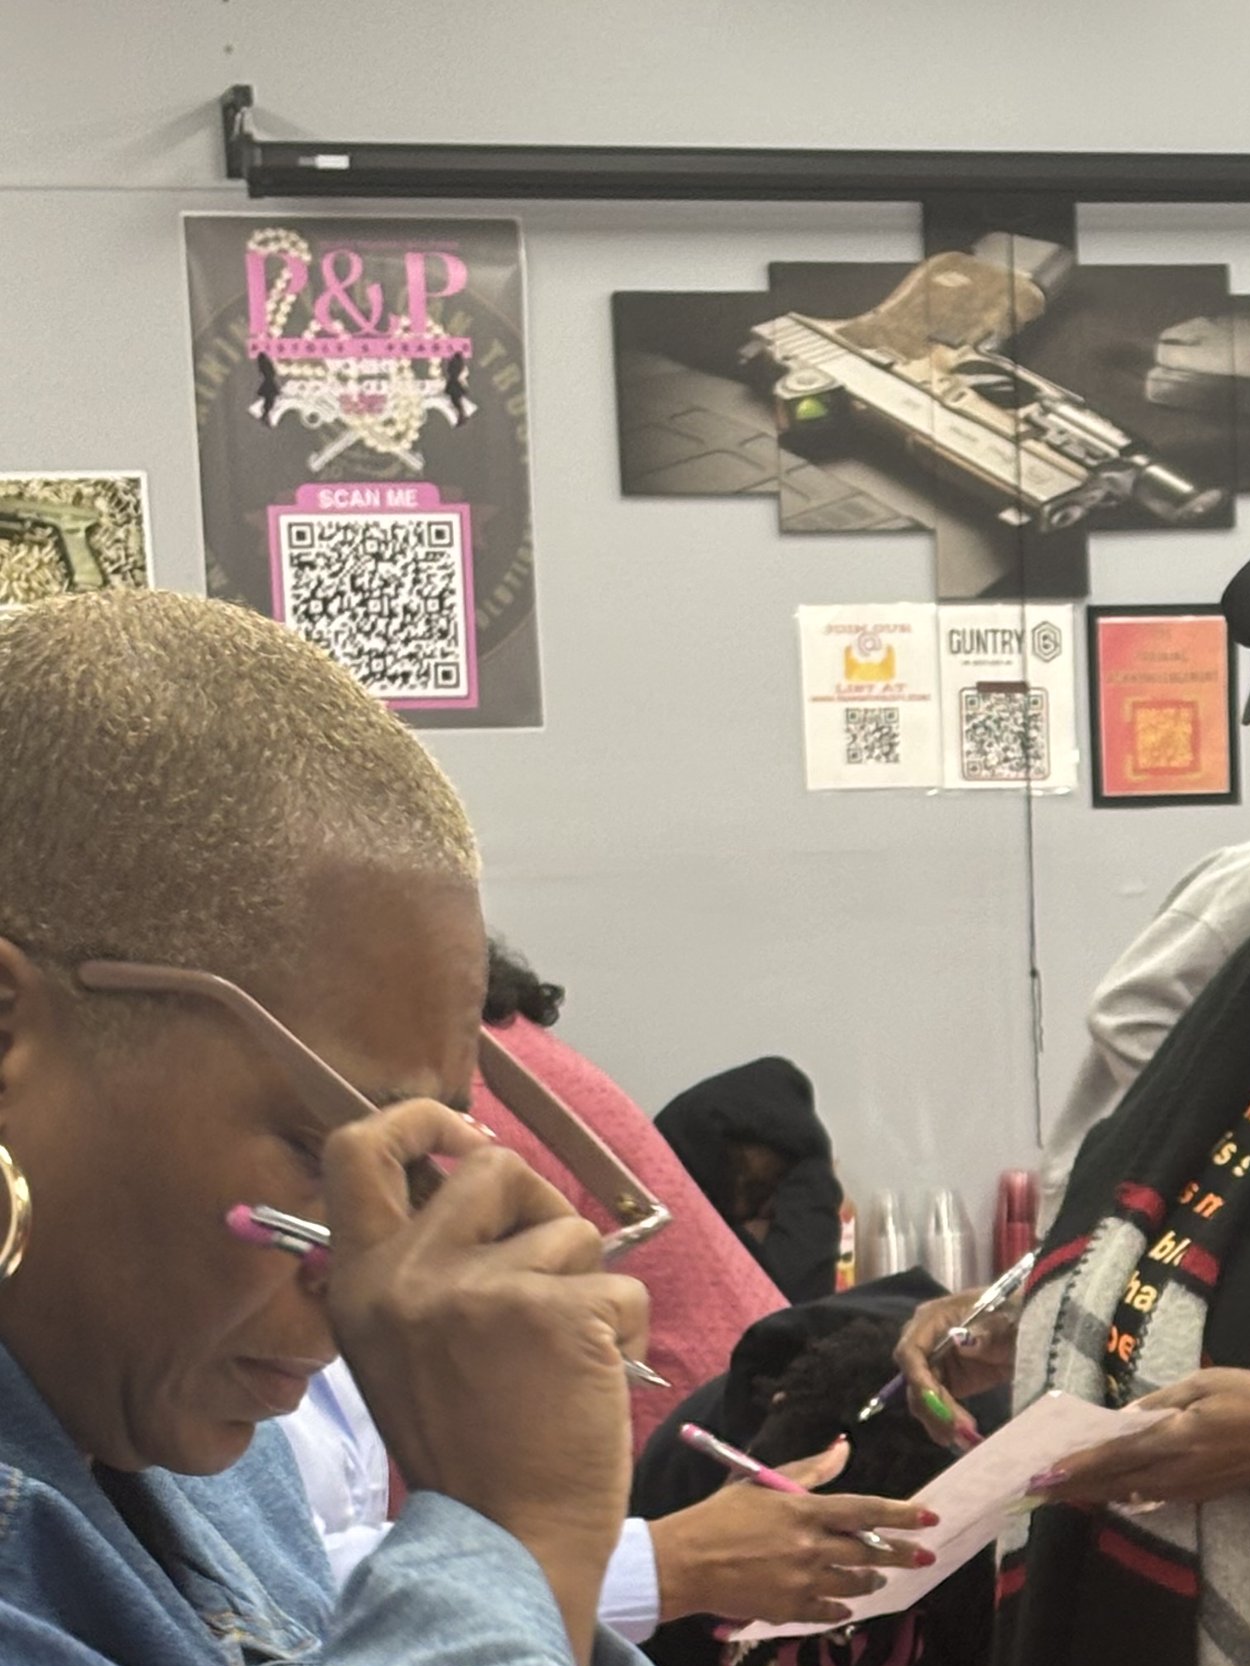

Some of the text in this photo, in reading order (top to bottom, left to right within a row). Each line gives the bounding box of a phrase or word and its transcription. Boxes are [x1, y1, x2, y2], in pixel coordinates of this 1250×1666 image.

[246, 249, 468, 338] P&P
[318, 488, 419, 509] SCAN ME
[825, 623, 867, 635] JOIN
[948, 627, 1026, 656] GUNTRY
